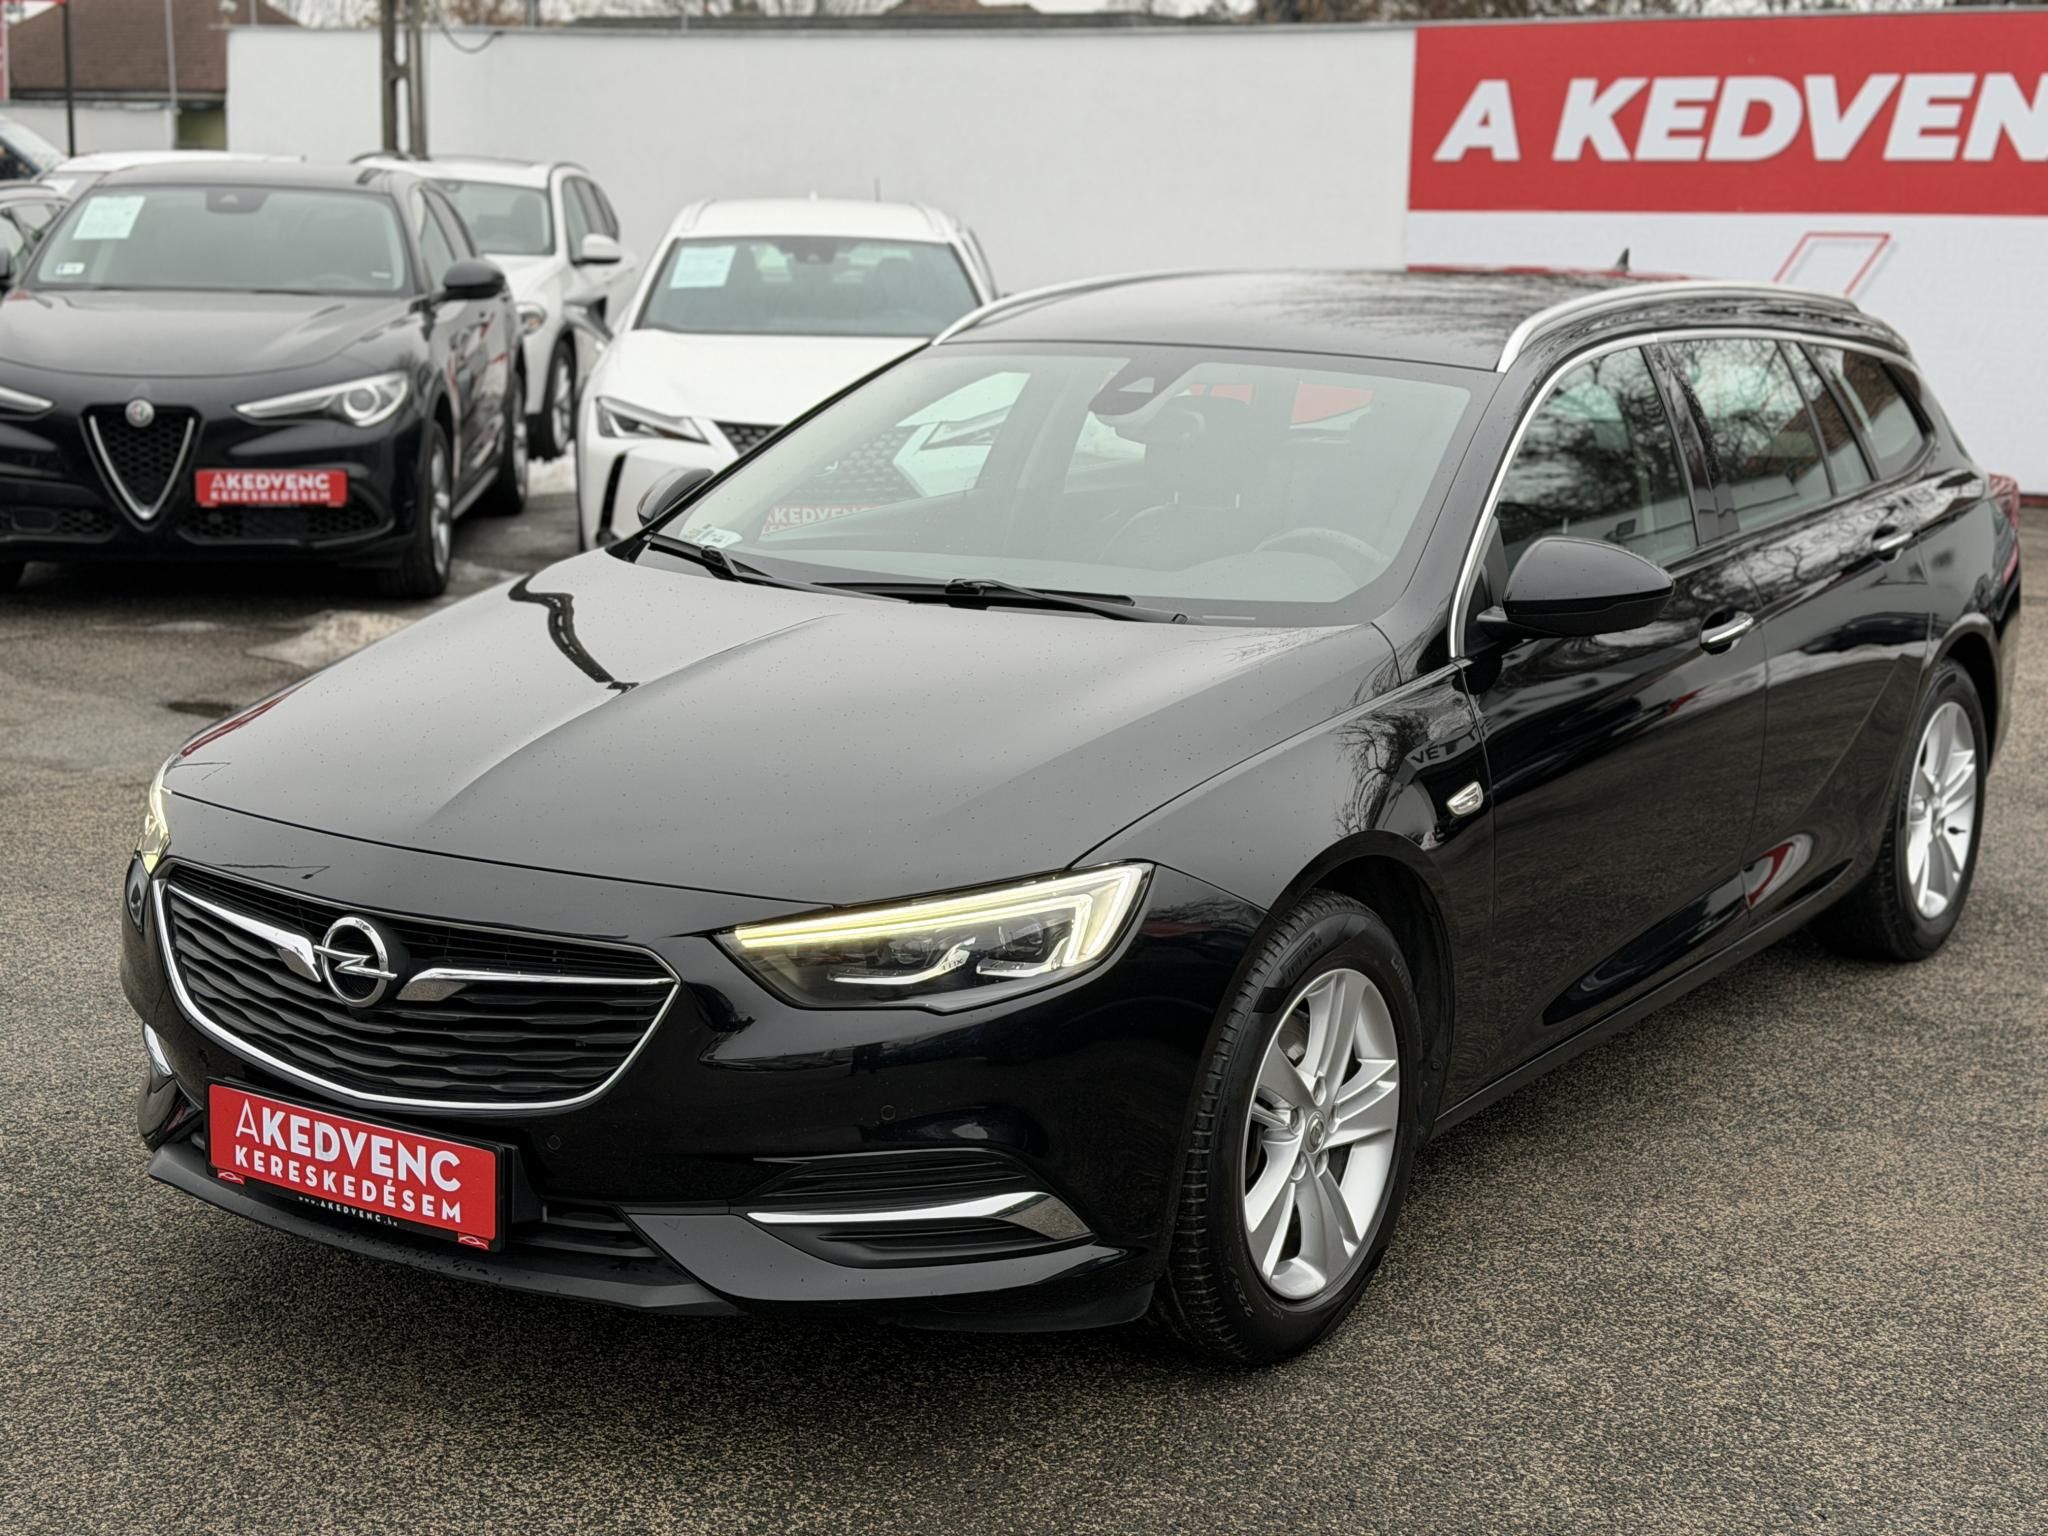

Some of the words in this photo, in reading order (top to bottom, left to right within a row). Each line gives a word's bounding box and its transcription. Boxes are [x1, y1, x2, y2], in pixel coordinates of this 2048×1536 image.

[1432, 79, 1520, 162] A
[210, 473, 330, 489] AKEDVENC
[235, 1098, 461, 1192] AKEDVENC
[235, 1144, 461, 1224] KERESKEDÉSEM
